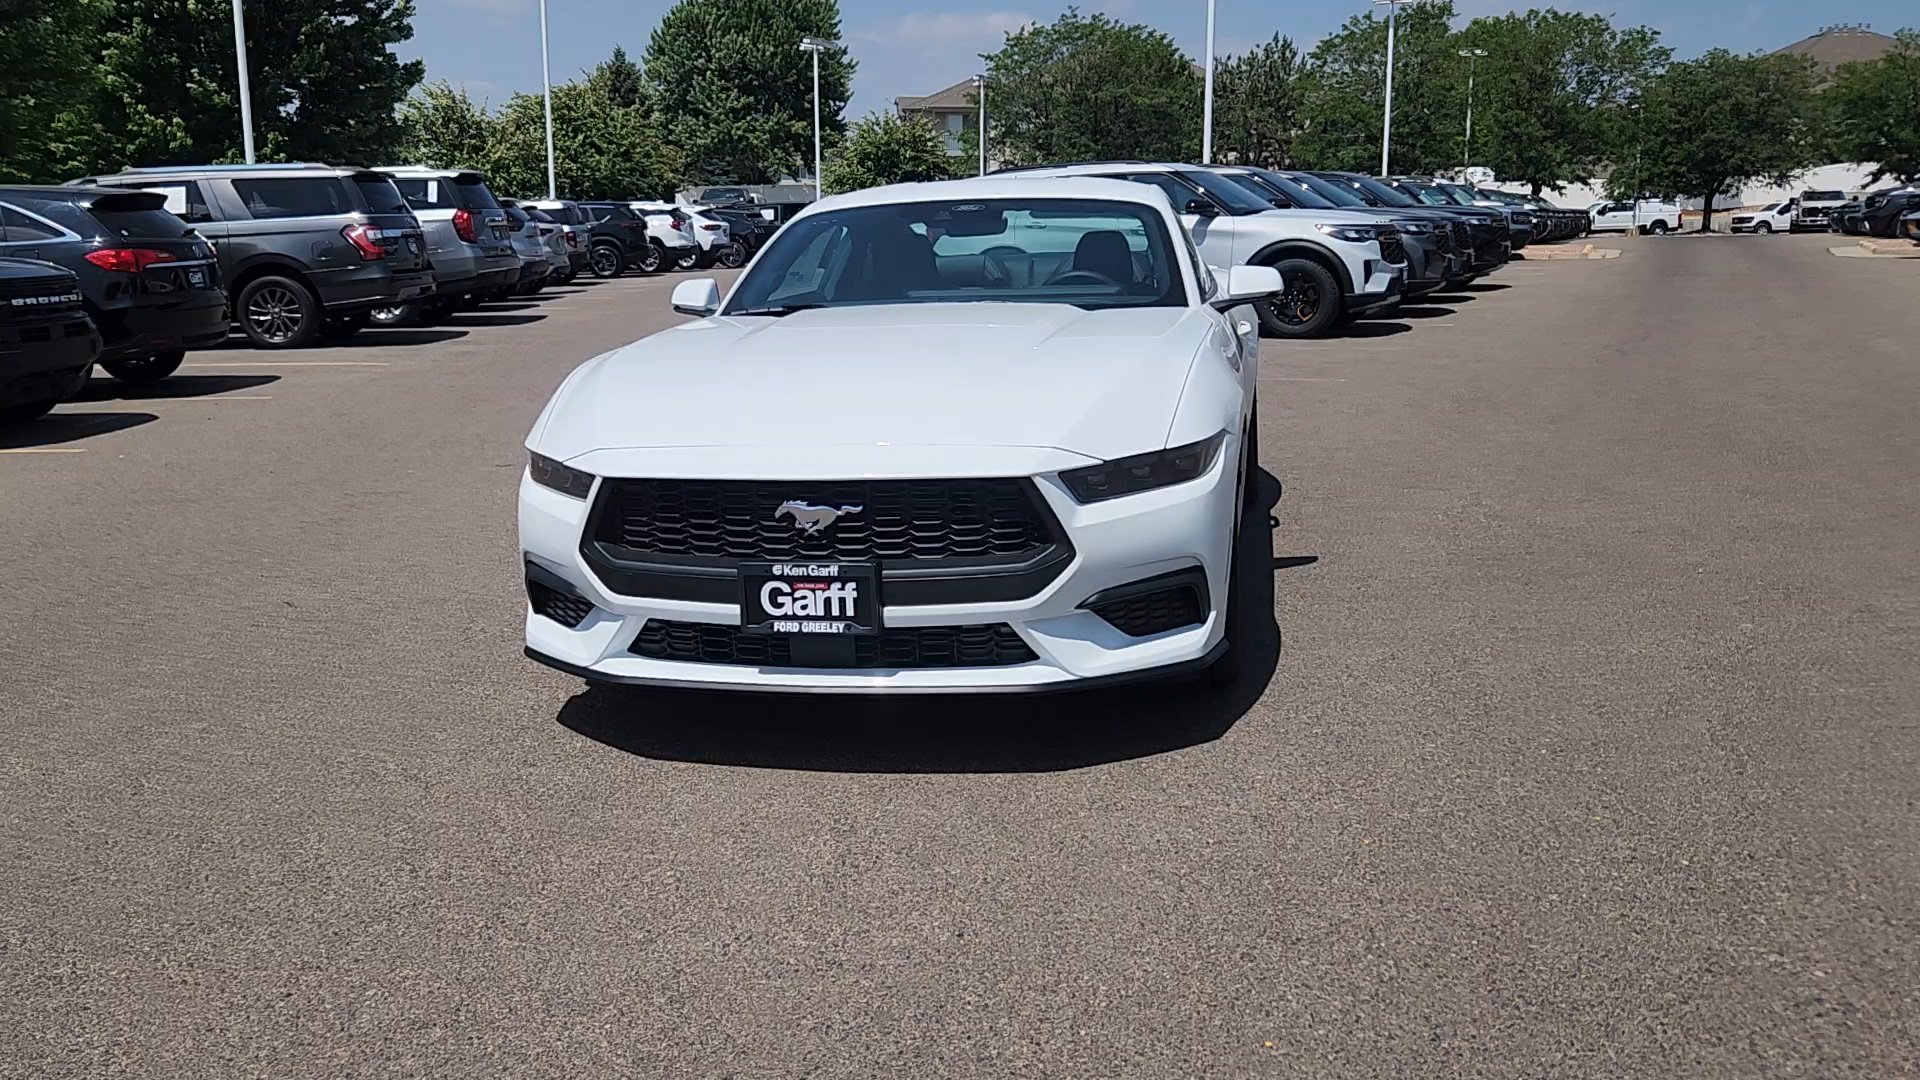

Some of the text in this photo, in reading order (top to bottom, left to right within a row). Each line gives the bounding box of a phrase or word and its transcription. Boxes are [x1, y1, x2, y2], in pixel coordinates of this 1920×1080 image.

[11, 294, 78, 306] BRONCO
[783, 565, 839, 576] Ken Garff
[760, 580, 858, 617] Garff
[773, 621, 845, 633] FORD GREELEY
